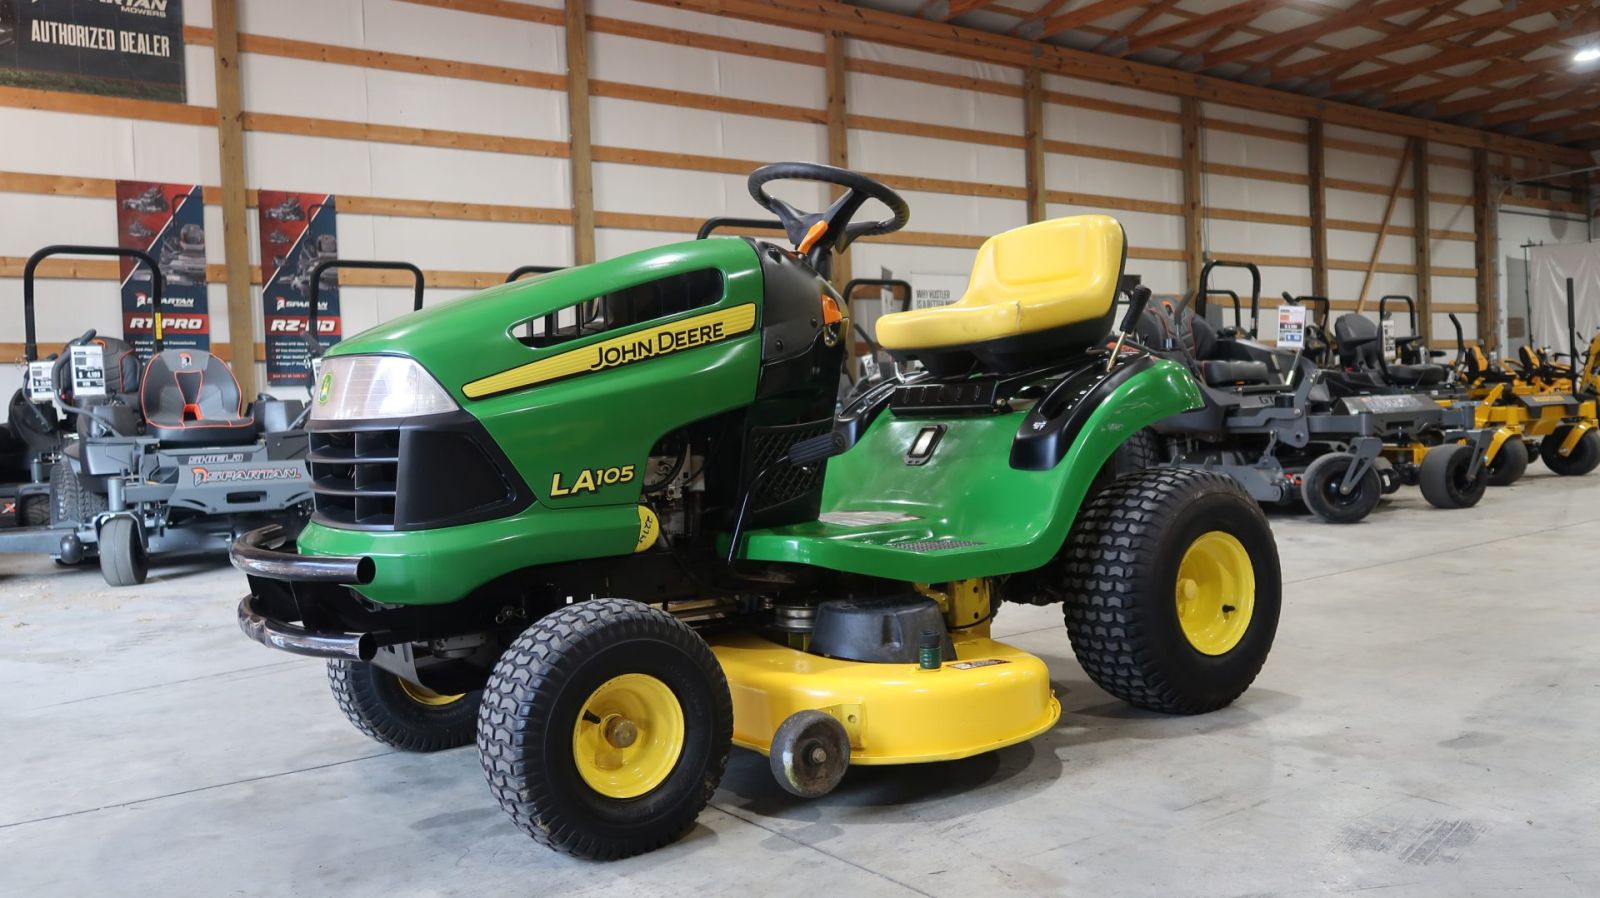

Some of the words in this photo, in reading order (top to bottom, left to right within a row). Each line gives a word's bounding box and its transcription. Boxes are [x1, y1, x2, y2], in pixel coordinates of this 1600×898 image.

[121, 6, 166, 18] MOWERS
[31, 19, 116, 51] AUTHORIZED
[120, 31, 170, 57] DEALER
[916, 290, 928, 299] WHY
[929, 290, 950, 299] HUSTLER
[147, 297, 194, 305] SARTAN
[286, 300, 328, 308] SPARAN
[130, 318, 202, 329] RTPRO
[590, 338, 653, 369] JOHN
[657, 321, 724, 352] DEERE
[208, 468, 298, 481] SPARTAN
[550, 465, 635, 497] LA105
